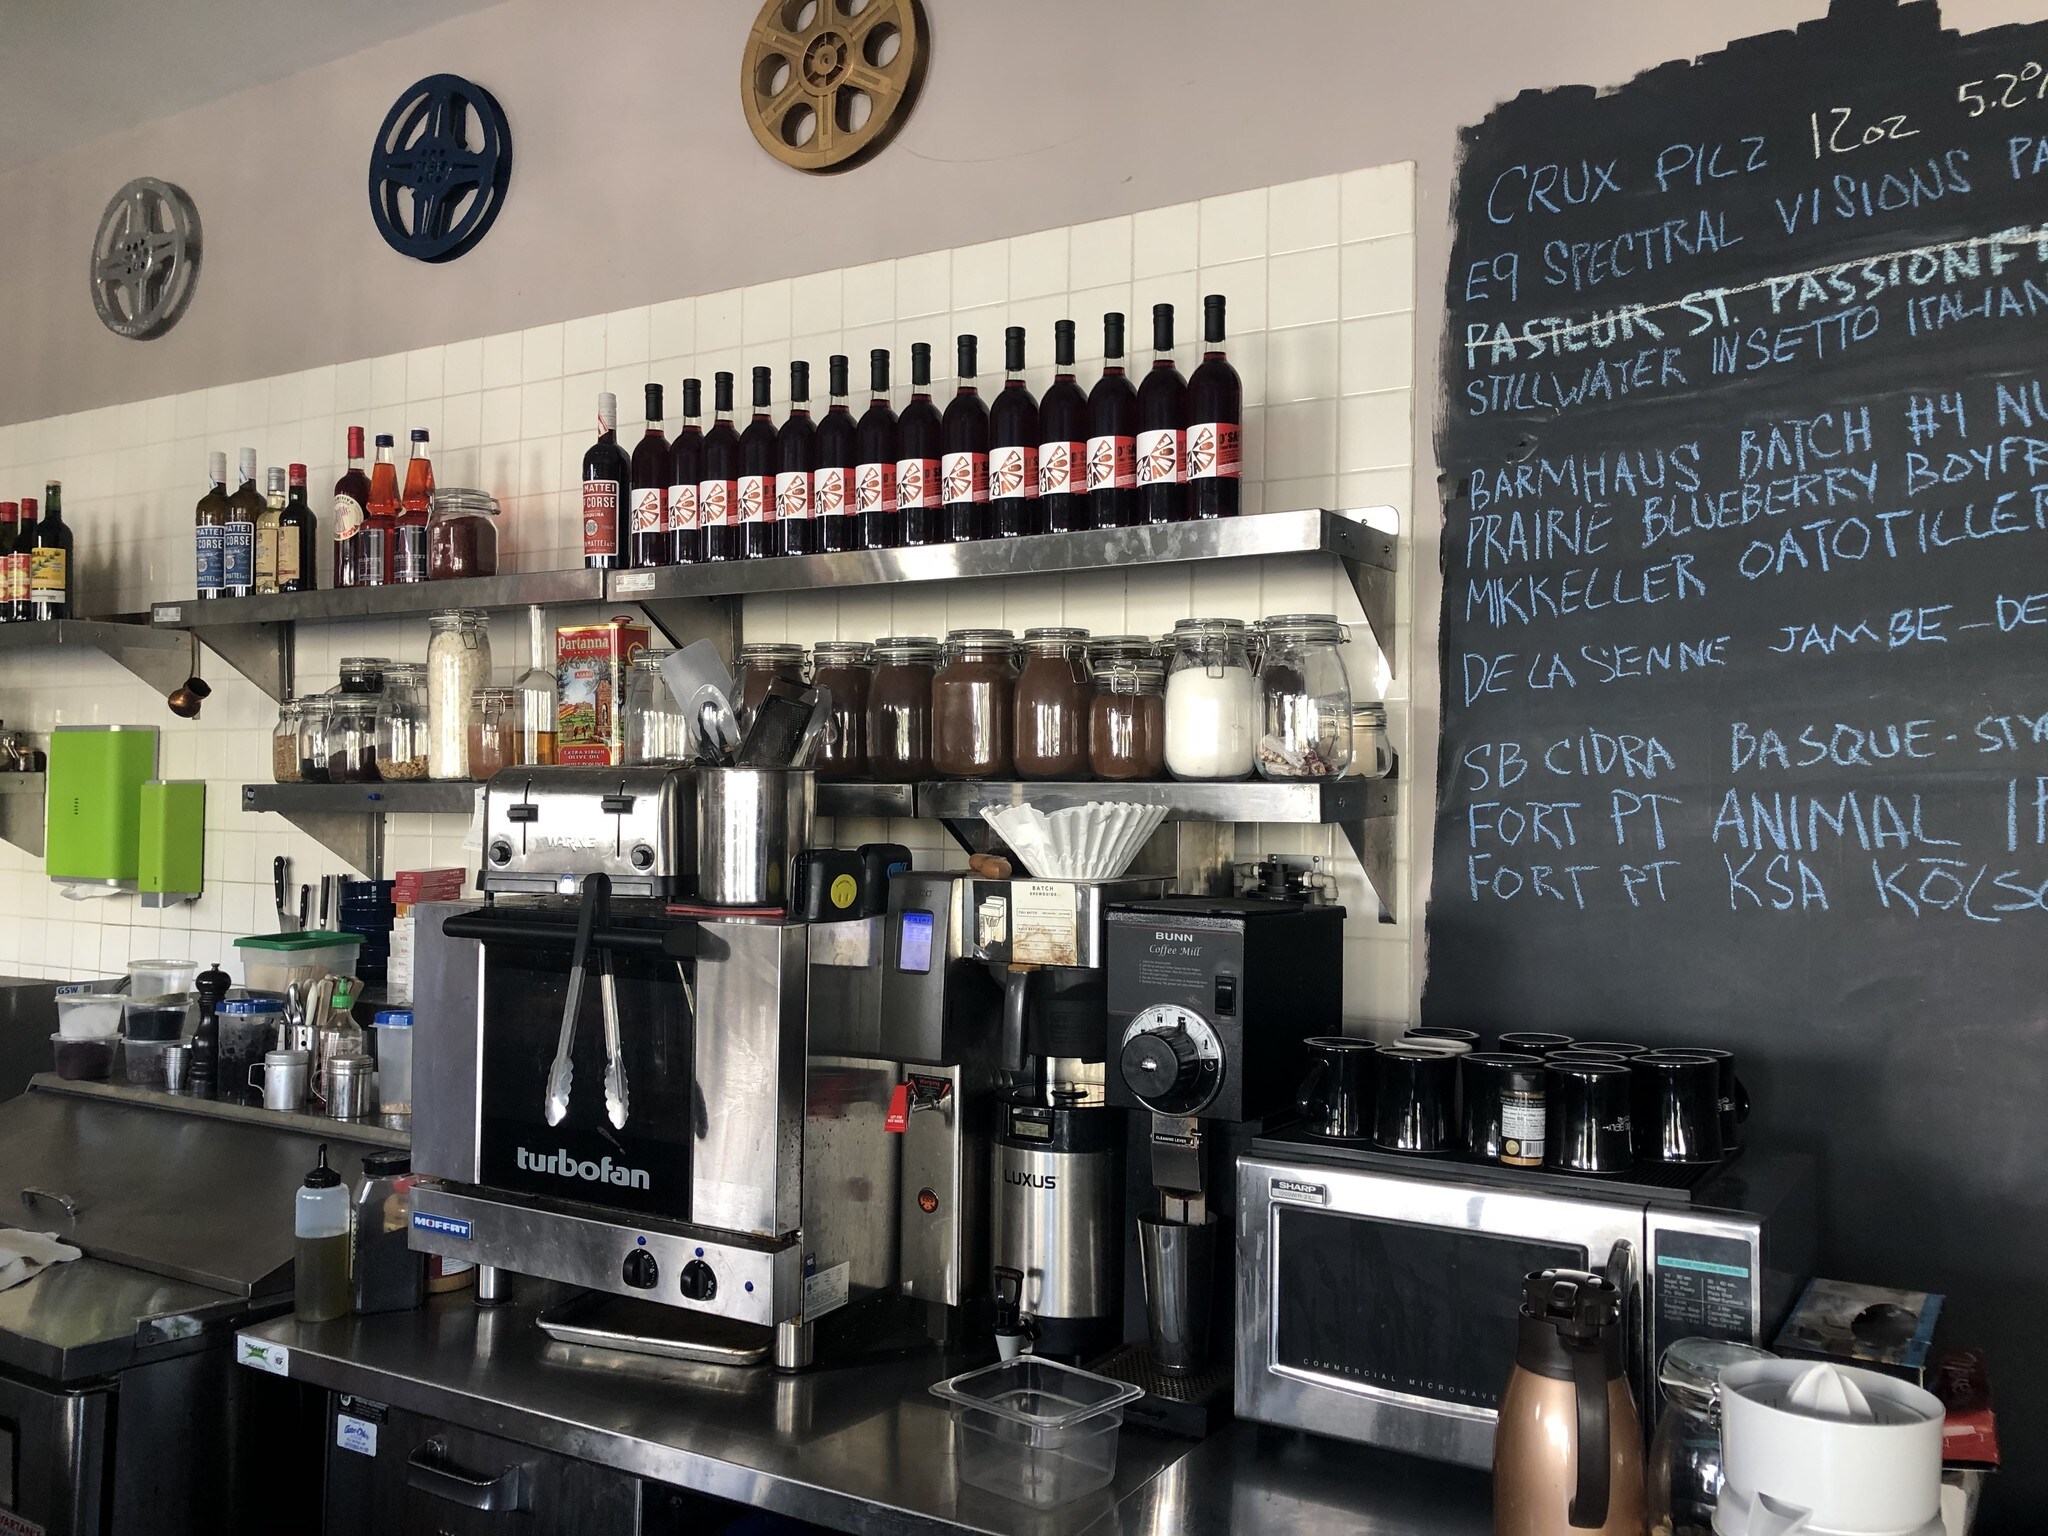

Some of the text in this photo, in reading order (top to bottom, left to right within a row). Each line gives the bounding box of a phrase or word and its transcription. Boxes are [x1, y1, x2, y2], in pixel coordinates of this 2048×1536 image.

[1488, 158, 1620, 223] CRUX
[1544, 210, 1743, 293] SPECTRAL
[1776, 149, 1971, 234] VISIONS
[1465, 303, 1666, 369] PASTEUR
[1466, 348, 1688, 416] STILLWATER
[1712, 306, 1881, 375] INSETTO
[1469, 441, 1701, 510] BARMHAUS
[1739, 407, 1873, 481] BATCH
[1905, 391, 1968, 446] #4
[1466, 502, 1612, 569] PRAIRIE
[1642, 461, 1878, 549] BLUEBERRY
[1466, 553, 1707, 627] MIKKELLER
[558, 636, 609, 656] Partanna
[1463, 742, 1528, 791] SB
[1544, 727, 1677, 780] CIDRA
[1469, 801, 1582, 849] FORT
[1610, 788, 1682, 851] PT
[1711, 787, 1963, 852] ANIMAL
[1469, 853, 1600, 910] FORT
[1618, 860, 1682, 910] PT
[1724, 852, 1830, 911] KSA
[1149, 944, 1203, 957] Coffee Mill
[1155, 931, 1193, 942] BUNN
[57, 986, 79, 995] GSW
[517, 1147, 650, 1190] turbofan
[1004, 1168, 1056, 1189] LUXUS
[1278, 1181, 1317, 1193] SHARP
[414, 1216, 468, 1234] MOFFAT
[1303, 1358, 1498, 1402] COMMERCIAL MICROWAVE
